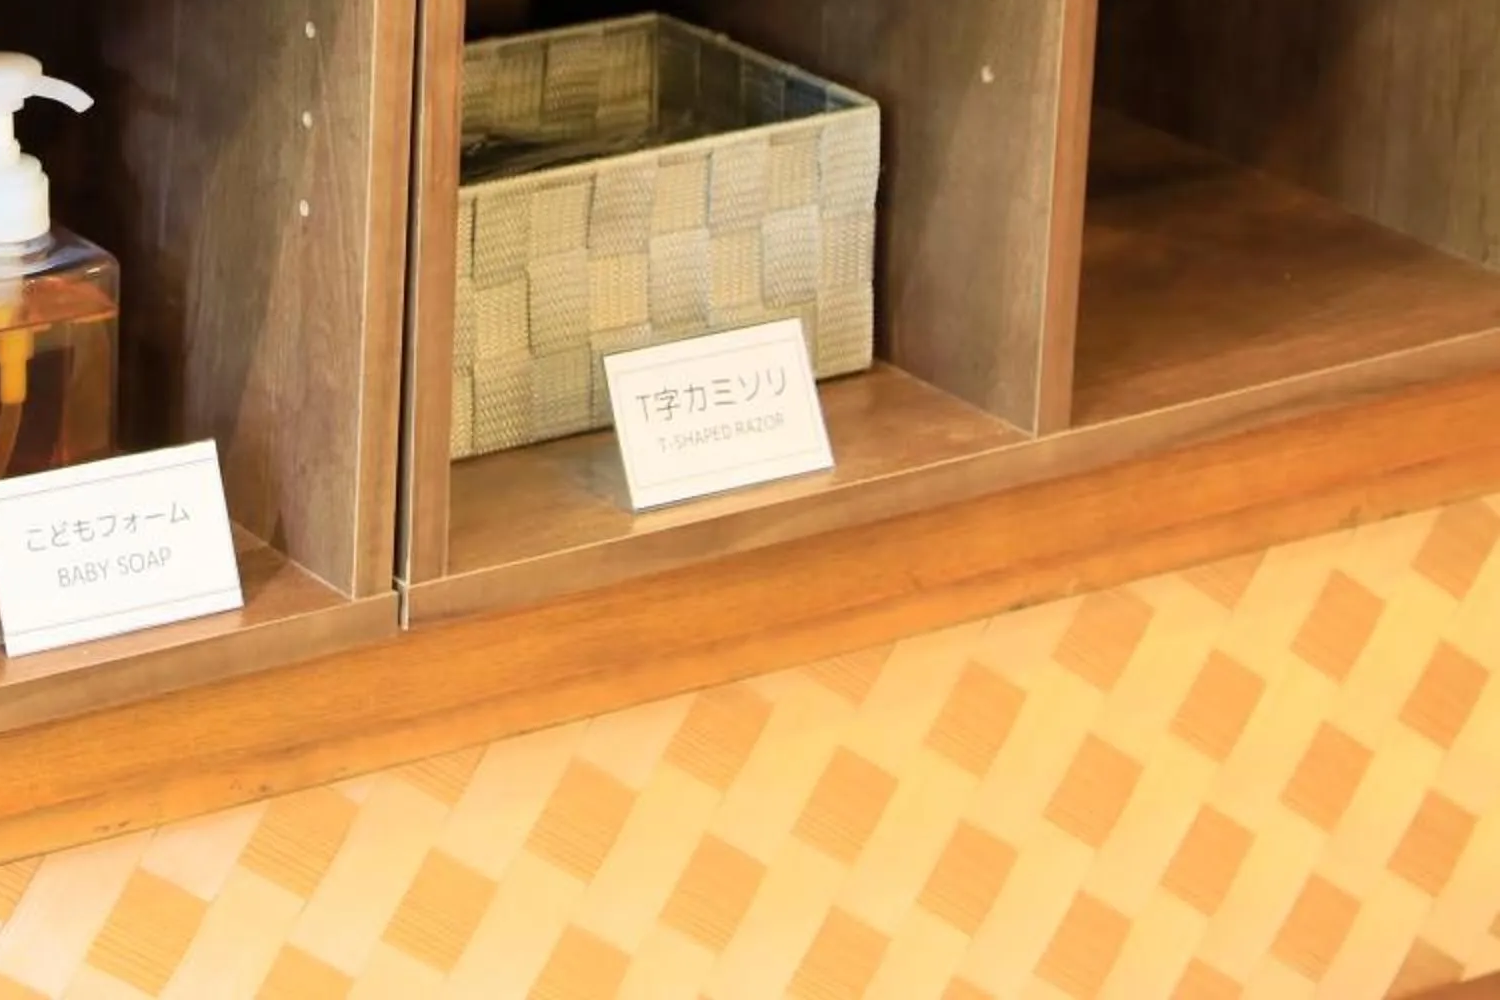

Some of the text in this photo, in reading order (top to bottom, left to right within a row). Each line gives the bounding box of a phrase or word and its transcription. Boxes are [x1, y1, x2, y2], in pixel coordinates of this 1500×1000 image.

[636, 366, 787, 422] T字カミソリ
[735, 412, 786, 436] RAZOR
[25, 502, 191, 552] こどもフォーム
[57, 546, 173, 588] BABY SOAP
